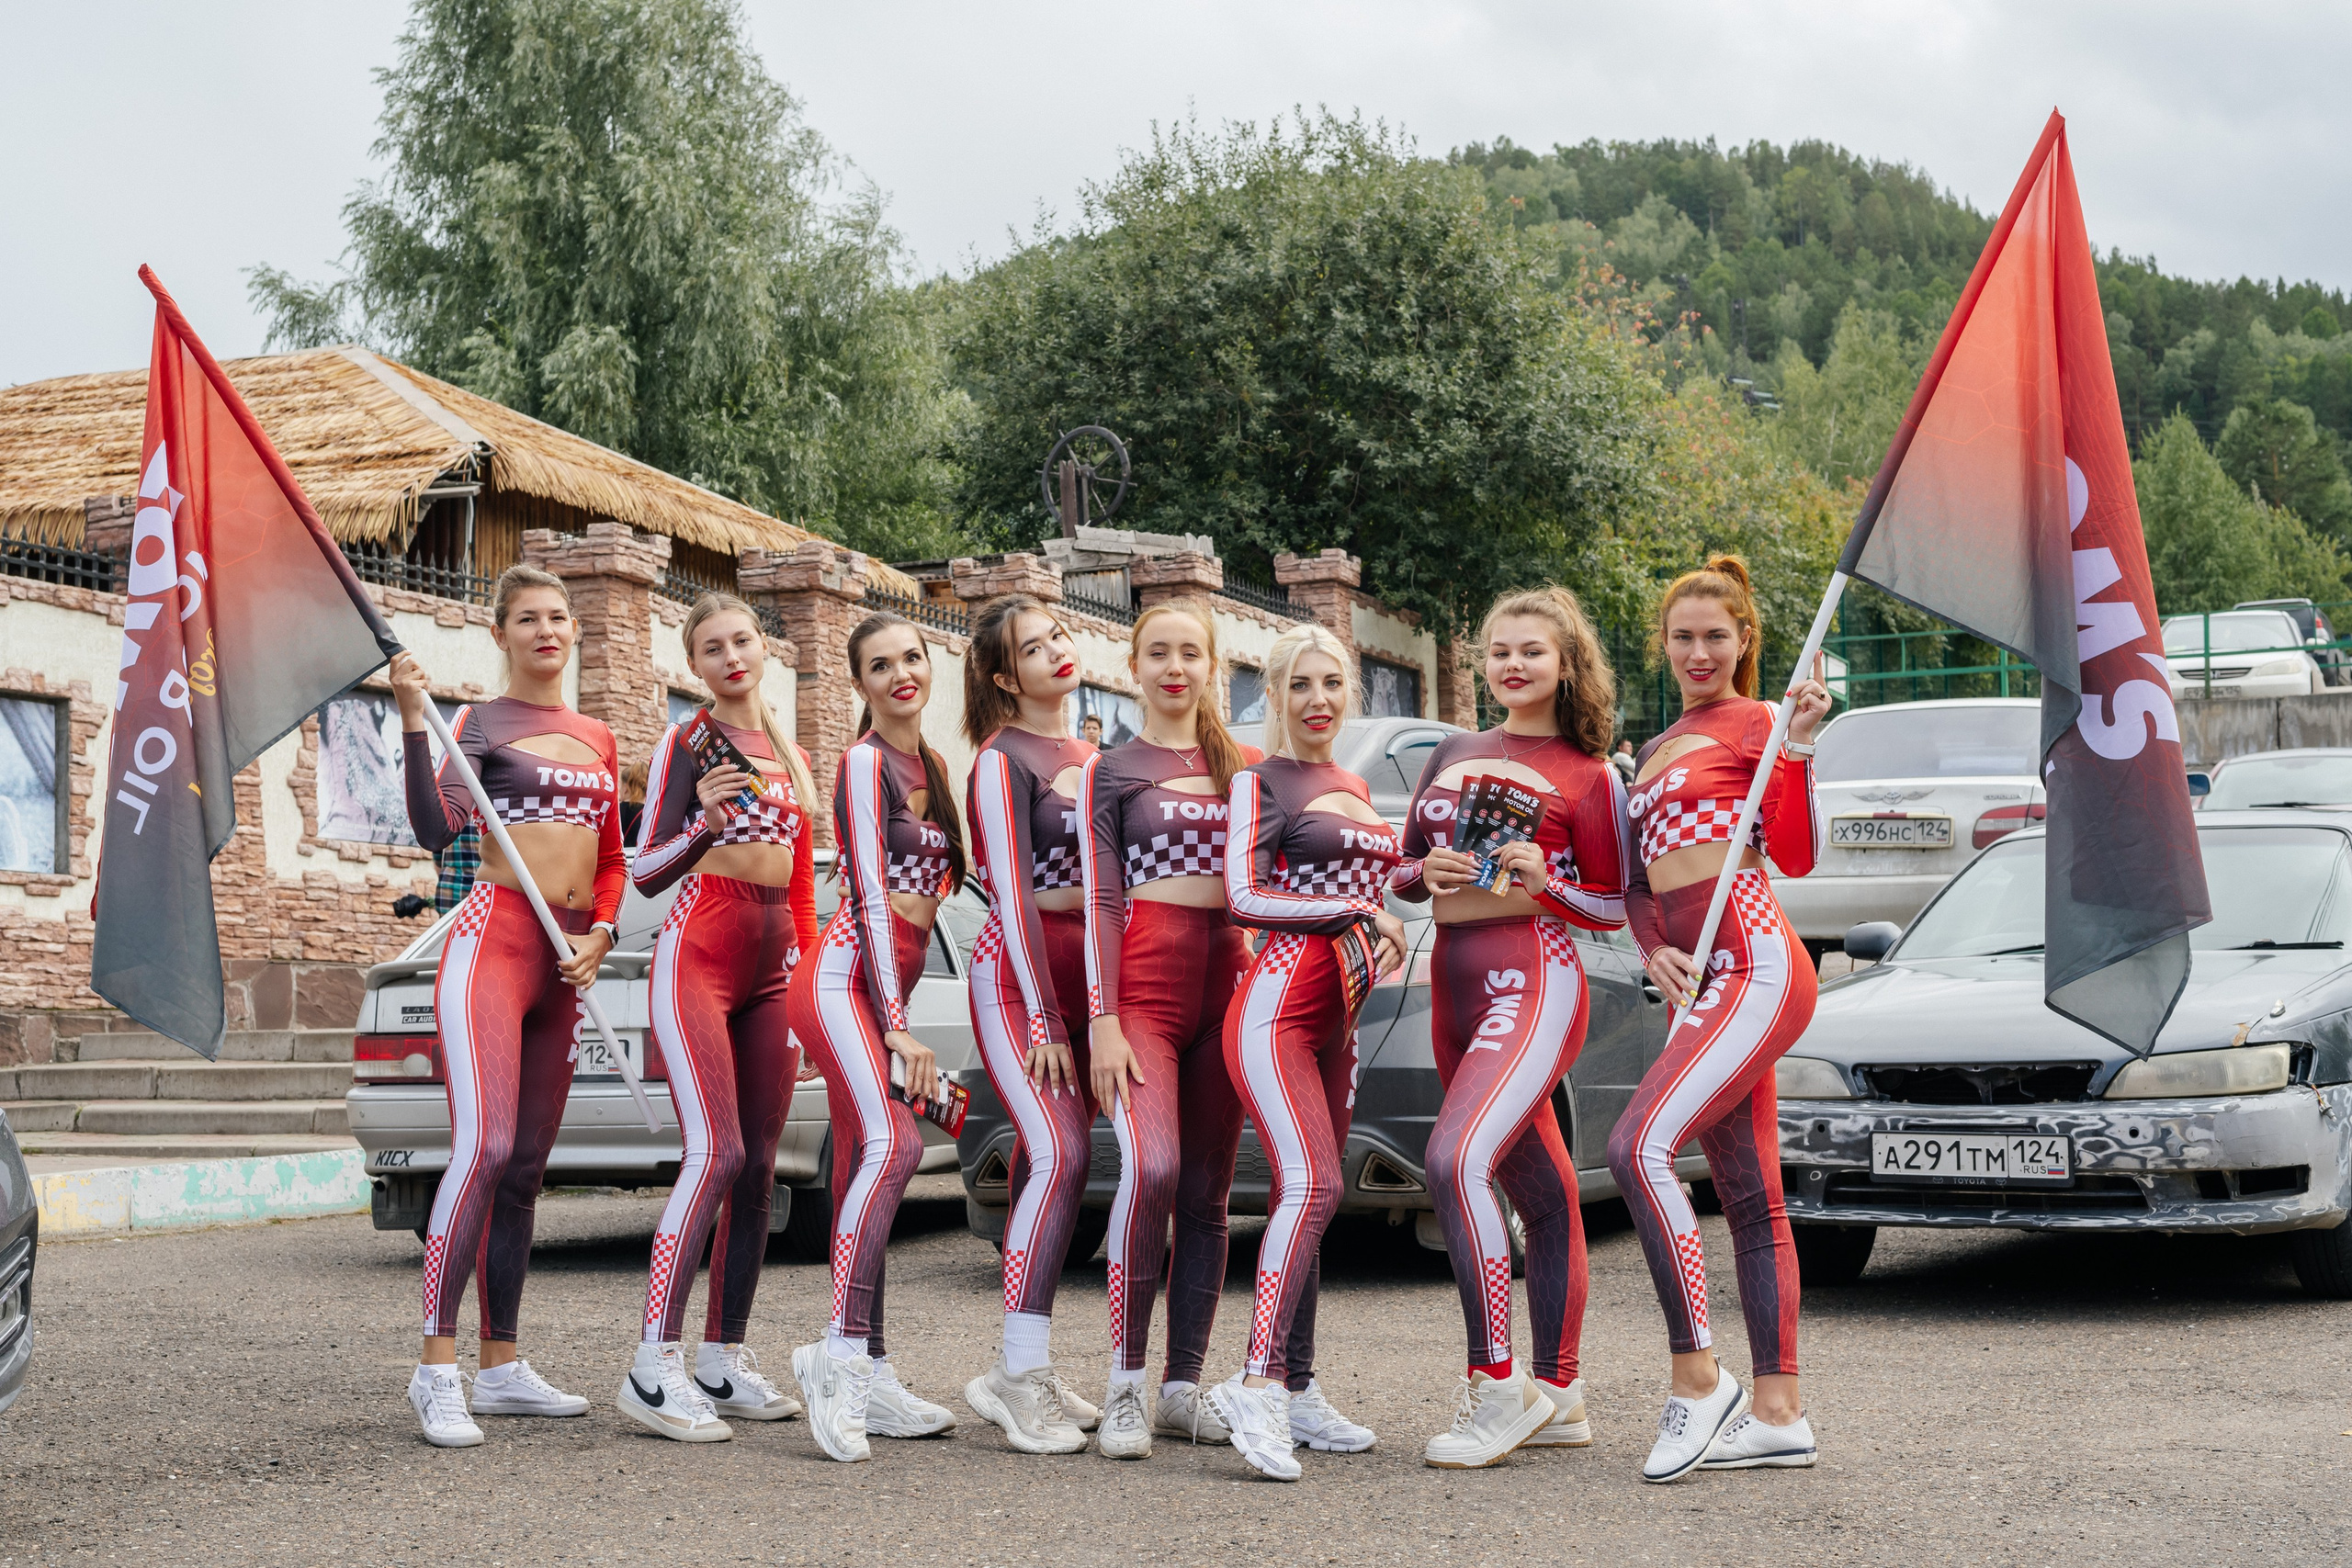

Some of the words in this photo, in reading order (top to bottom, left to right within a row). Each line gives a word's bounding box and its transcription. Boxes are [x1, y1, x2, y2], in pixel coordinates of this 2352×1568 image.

[2065, 456, 2181, 760] M'S
[688, 721, 707, 746] TOM'S
[537, 766, 615, 793] TOM'S
[763, 780, 799, 807] M'S
[1507, 786, 1540, 808] TOM'S
[1626, 766, 1690, 826] OM'S
[1159, 801, 1228, 821] TOM
[1504, 797, 1525, 811] MOTOR
[1524, 807, 1534, 816] OIL
[1466, 968, 1526, 1054] TOM'S
[584, 1044, 613, 1065] 12
[374, 1150, 415, 1167] KICX
[2012, 1140, 2060, 1164] 124
[1952, 1177, 1986, 1185] TOYOTA
[2023, 1166, 2047, 1175] RUS
